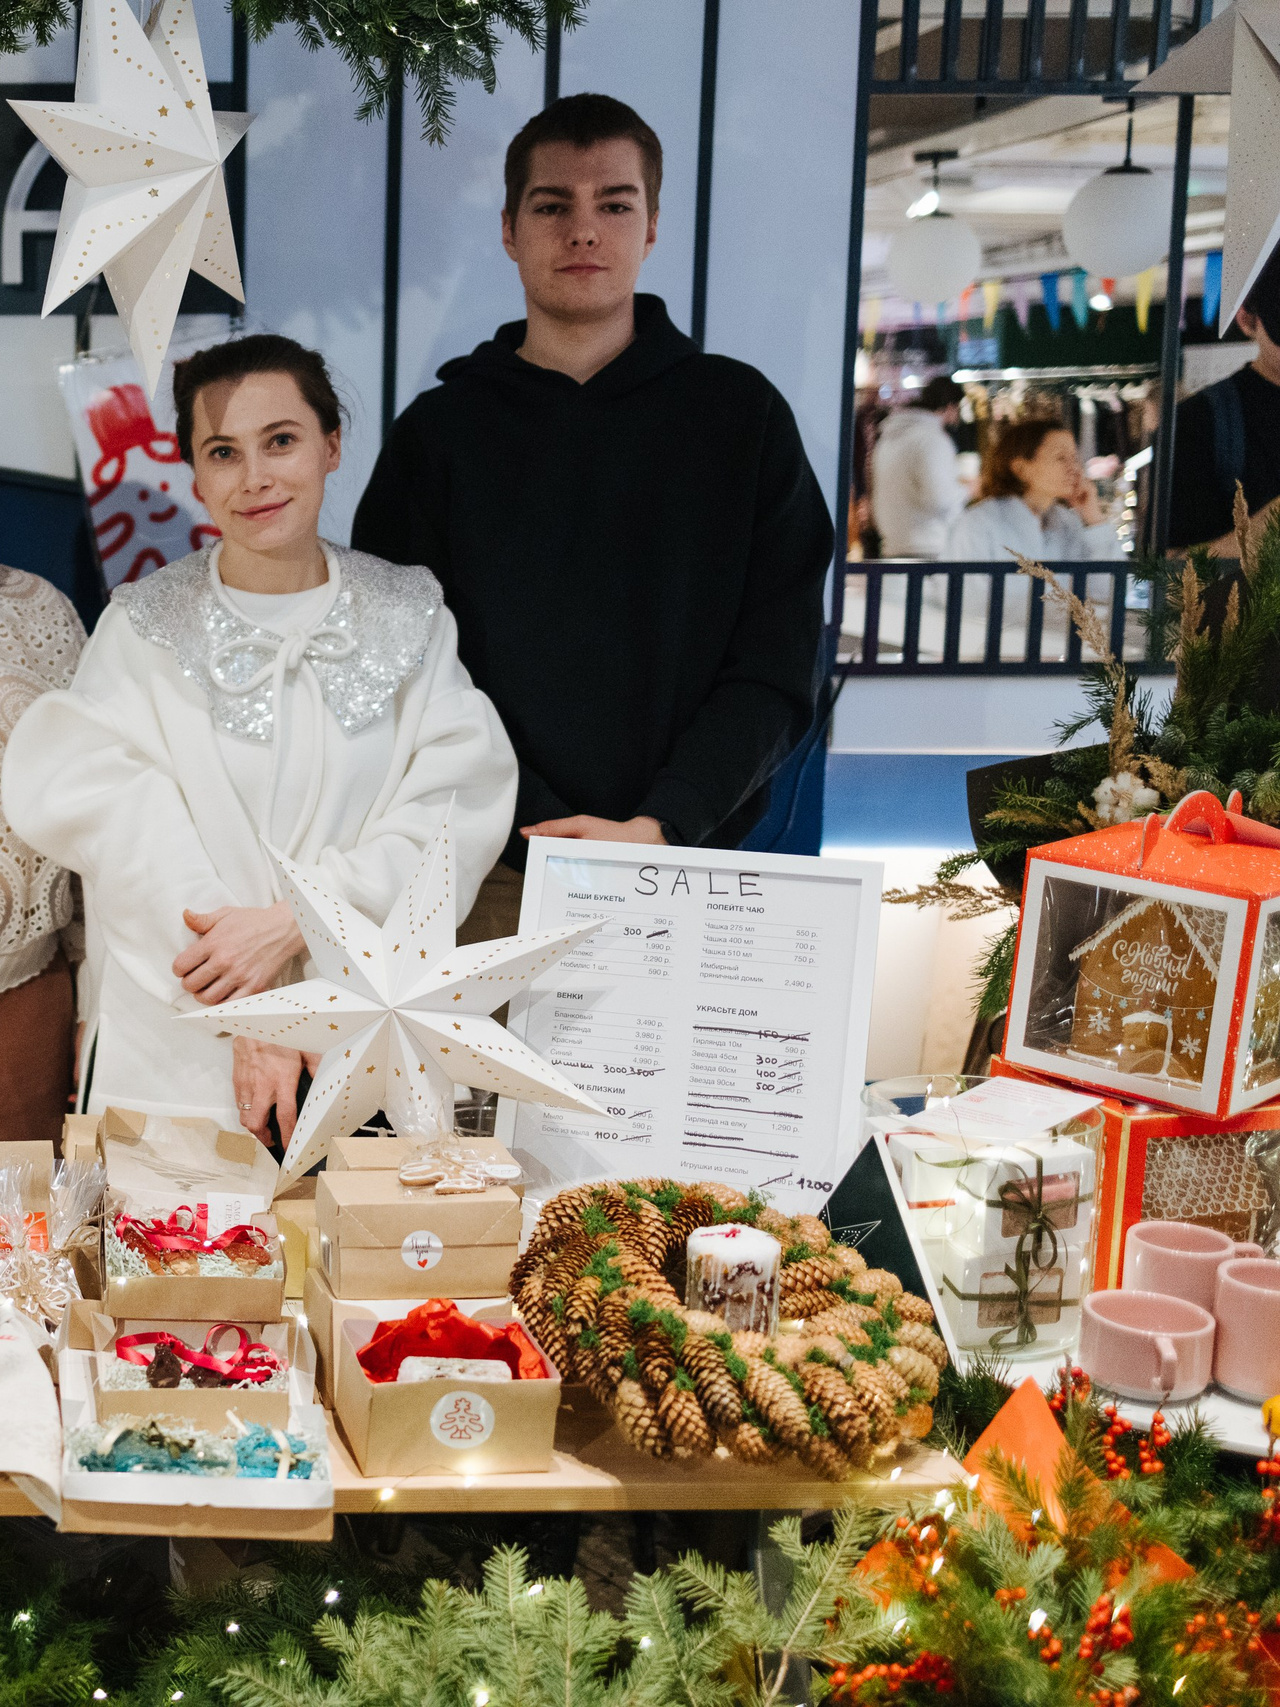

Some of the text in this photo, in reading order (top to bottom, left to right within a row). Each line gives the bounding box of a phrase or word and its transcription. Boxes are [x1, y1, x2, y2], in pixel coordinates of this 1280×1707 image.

[634, 865, 763, 897] SALE
[707, 903, 744, 912] ПОПЕЙТЕ
[704, 922, 728, 931] Чашка
[704, 935, 727, 944] Чашка
[702, 947, 726, 956] Чашка
[700, 962, 739, 971] Имбирный
[557, 992, 583, 1000] ВЕНКИ
[697, 1005, 736, 1015] УКРАСЬТЕ
[554, 1011, 593, 1020] Бланковый
[559, 1024, 591, 1034] Гирлянда
[551, 1036, 582, 1045] Красный
[693, 1037, 726, 1047] Гирлянда
[692, 1050, 717, 1059] Звезда
[756, 1055, 777, 1065] 300
[603, 1064, 627, 1074] 3000
[690, 1063, 716, 1072] Звезда
[756, 1069, 776, 1078] 400
[689, 1076, 715, 1085] Звезда
[587, 1085, 626, 1094] БЛИЗКИМ
[756, 1082, 775, 1091] 500
[685, 1115, 718, 1125] Гирлянда
[594, 1131, 618, 1140] 1100
[680, 1161, 712, 1170] Игрушки
[796, 1177, 833, 1192] 1200
